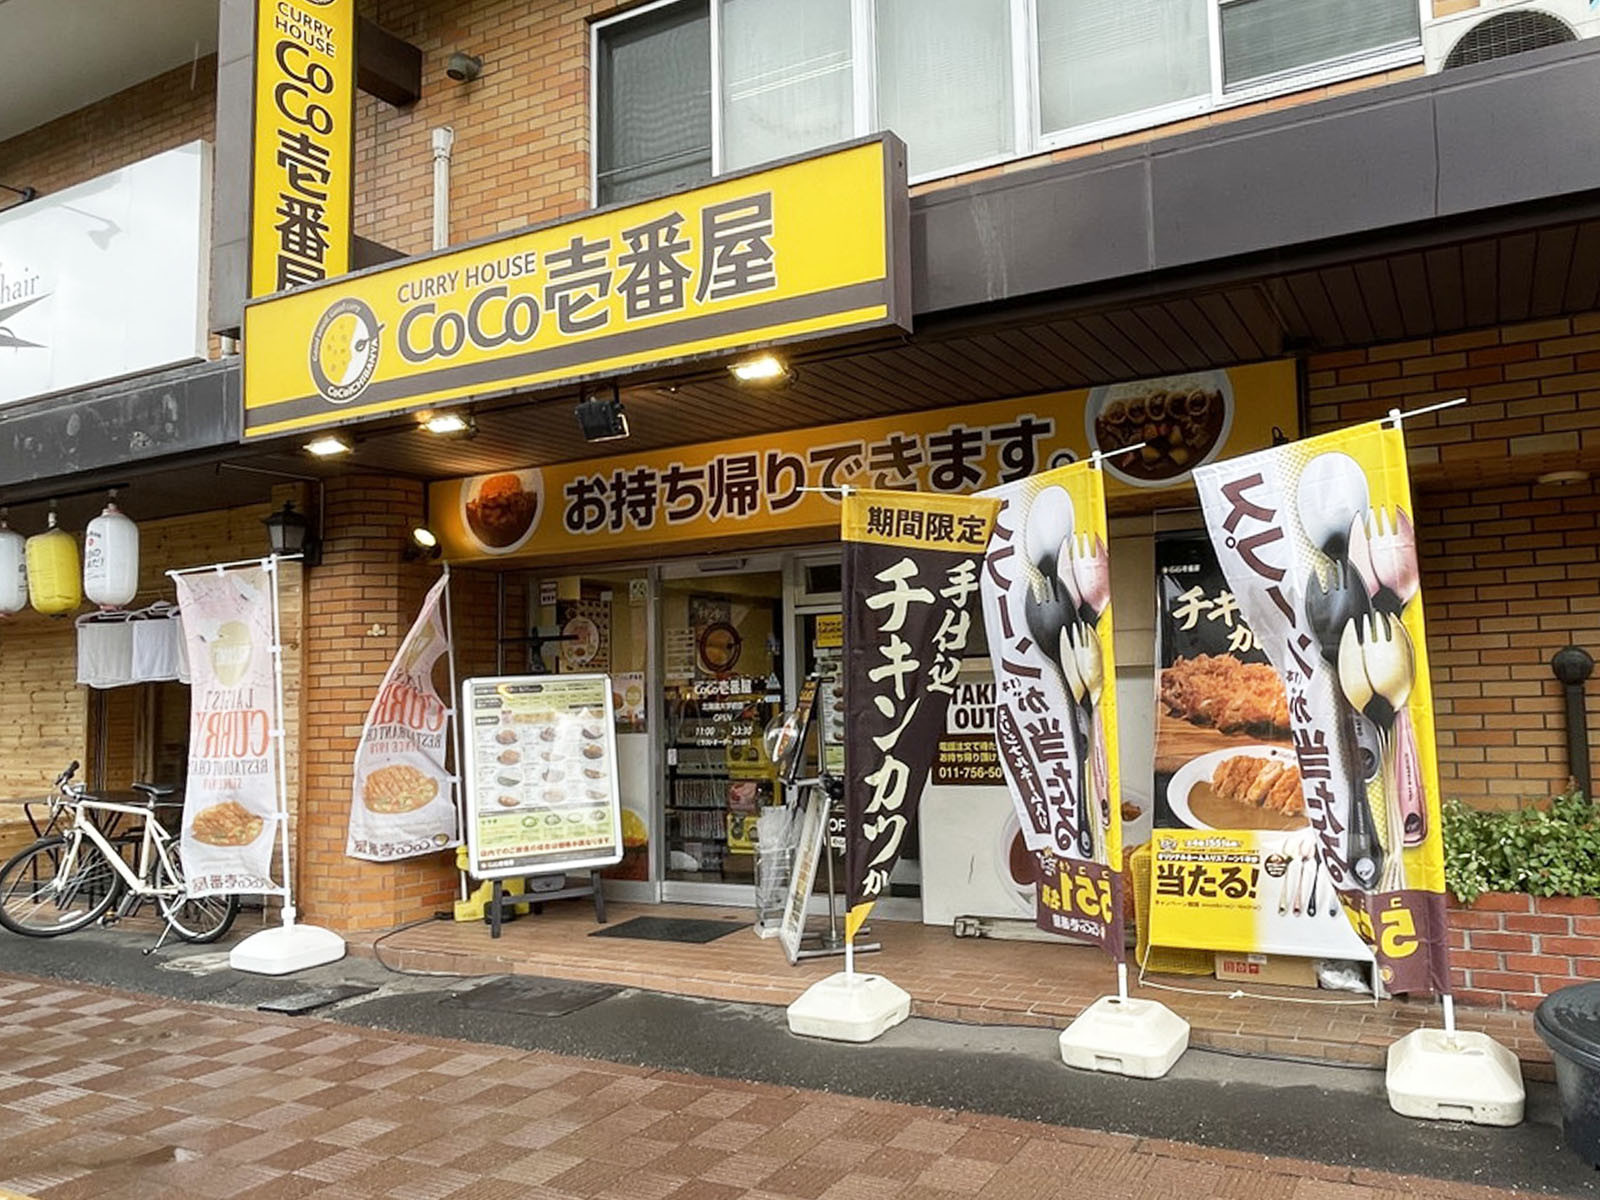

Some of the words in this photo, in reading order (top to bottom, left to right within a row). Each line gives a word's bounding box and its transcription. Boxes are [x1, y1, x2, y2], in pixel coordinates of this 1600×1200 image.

[275, 15, 335, 58] HOUSE
[278, 2, 333, 39] CURRY
[0, 273, 40, 304] hair
[397, 270, 459, 303] CURRY
[465, 252, 536, 288] HOUSE
[398, 191, 776, 363] CoCo壱番屋
[564, 414, 1078, 534] お持ち帰りできます。
[866, 505, 988, 545] 期間限定
[925, 558, 980, 695] 手仕込
[1156, 863, 1260, 900] 当たる!
